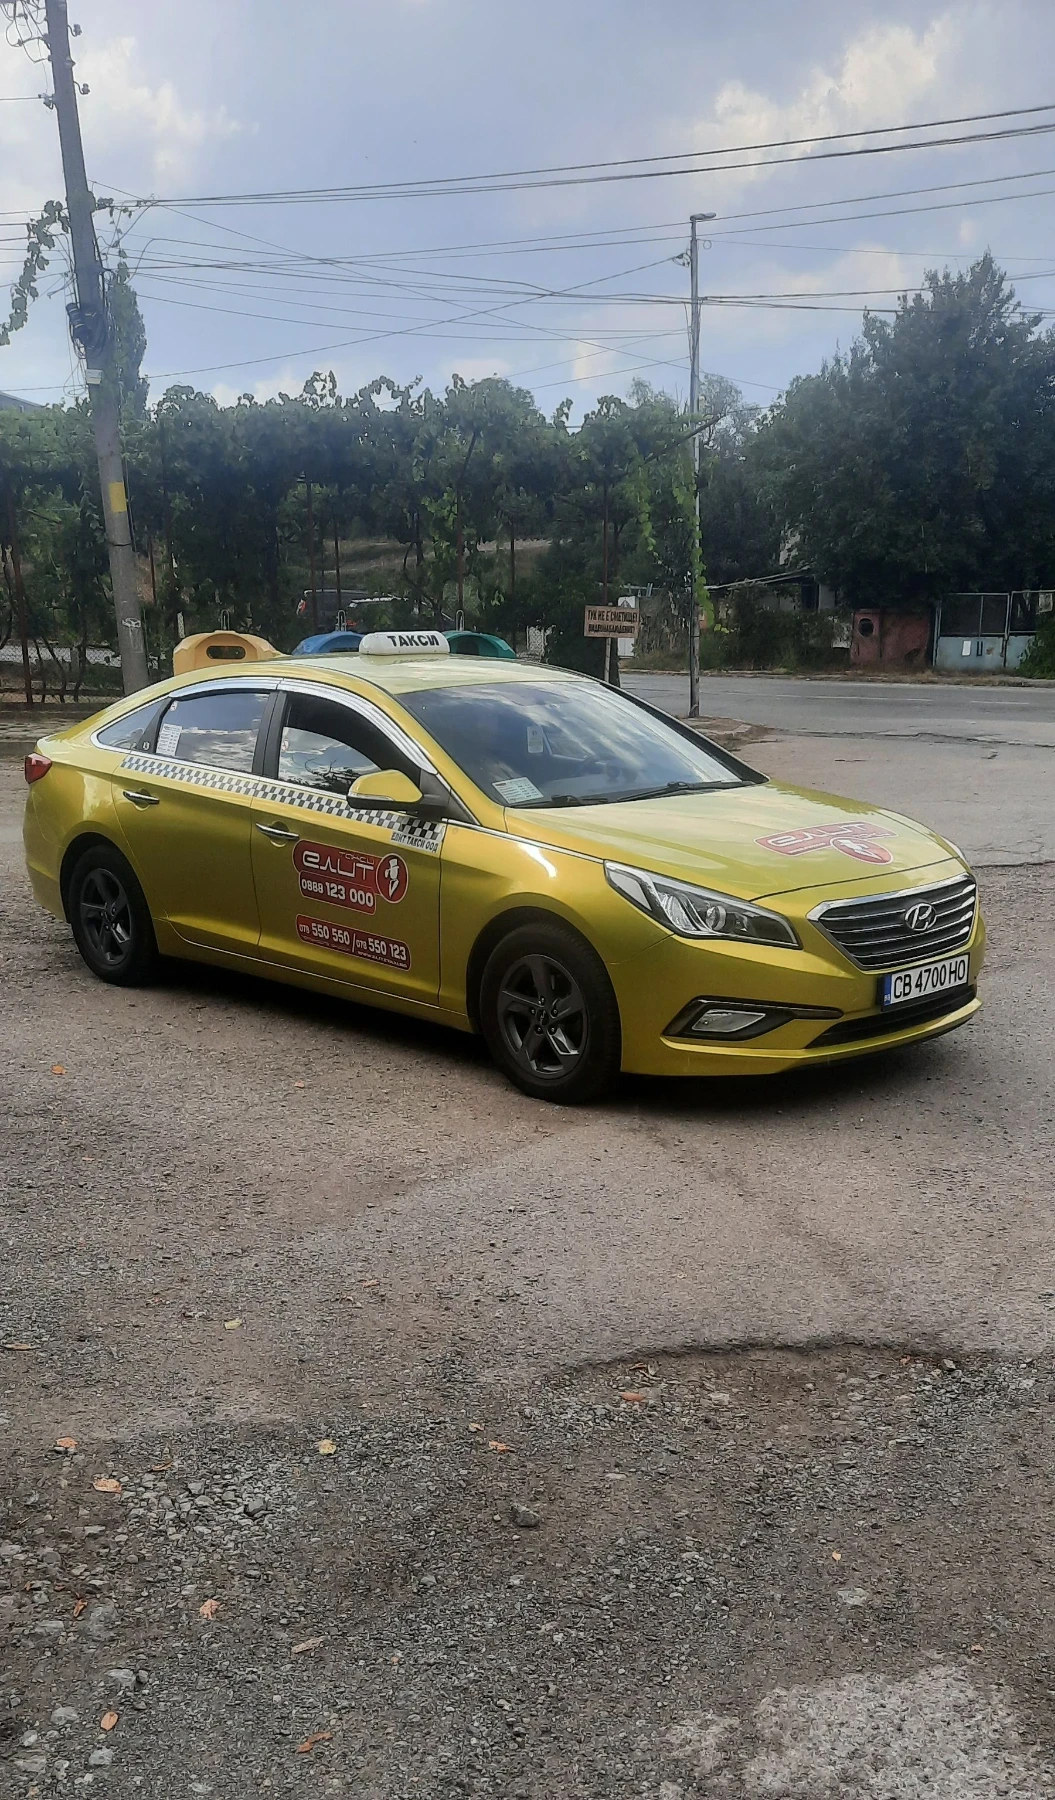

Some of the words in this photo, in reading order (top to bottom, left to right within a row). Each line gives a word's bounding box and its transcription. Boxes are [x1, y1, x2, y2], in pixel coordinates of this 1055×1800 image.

[387, 635, 440, 647] ТАКСИ
[391, 832, 407, 843] ЕЛИТ
[407, 835, 425, 848] ТАКСИ
[425, 841, 438, 853] ООД
[301, 879, 324, 894] 0888
[325, 882, 346, 900] 123
[349, 888, 374, 907] 000
[311, 923, 330, 940] 550
[331, 927, 350, 945] 550
[368, 937, 387, 956] 550
[389, 943, 407, 961] 123
[915, 964, 947, 993] 4700
